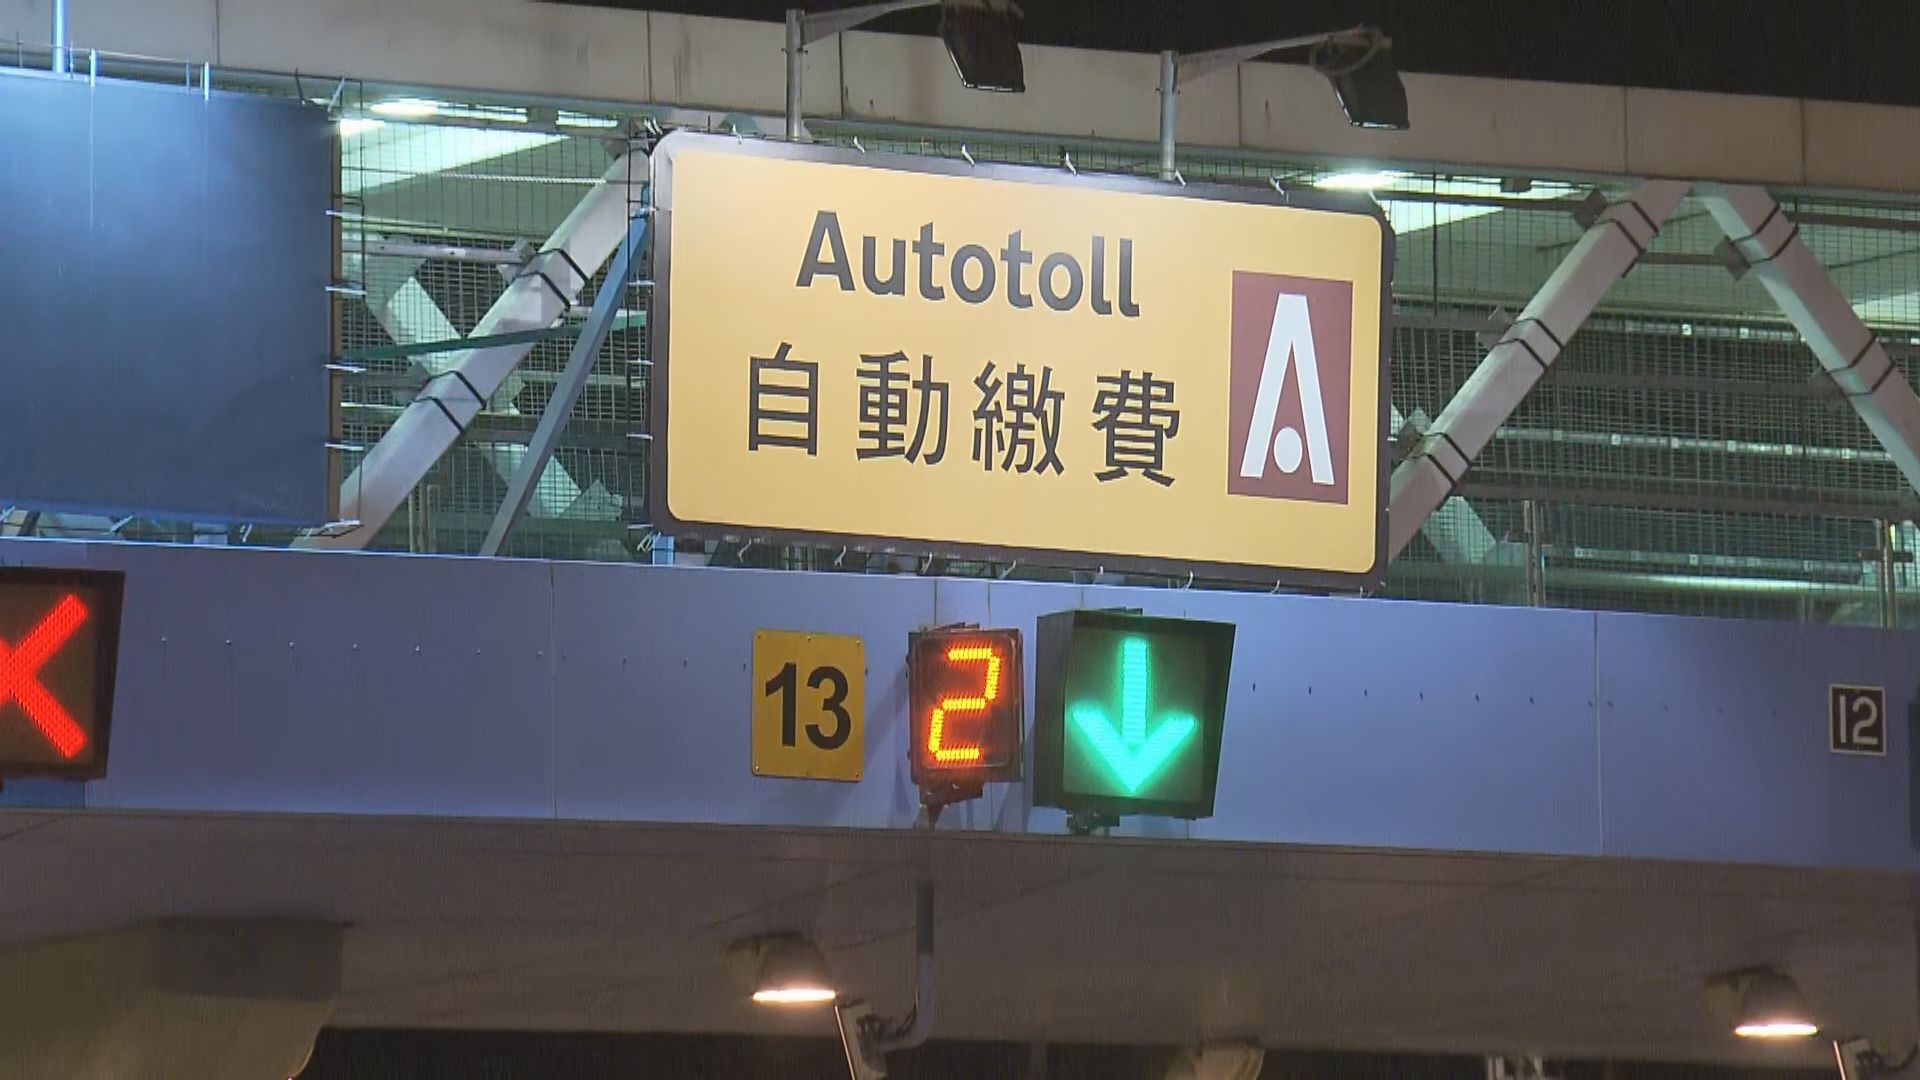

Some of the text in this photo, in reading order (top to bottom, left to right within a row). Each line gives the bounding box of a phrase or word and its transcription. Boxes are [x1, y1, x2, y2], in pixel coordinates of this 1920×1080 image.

[795, 209, 1141, 319] Autotoll
[747, 341, 1181, 487] 自動繳費
[764, 661, 852, 751] 13
[928, 646, 1001, 761] 2
[1839, 694, 1879, 745] 12
